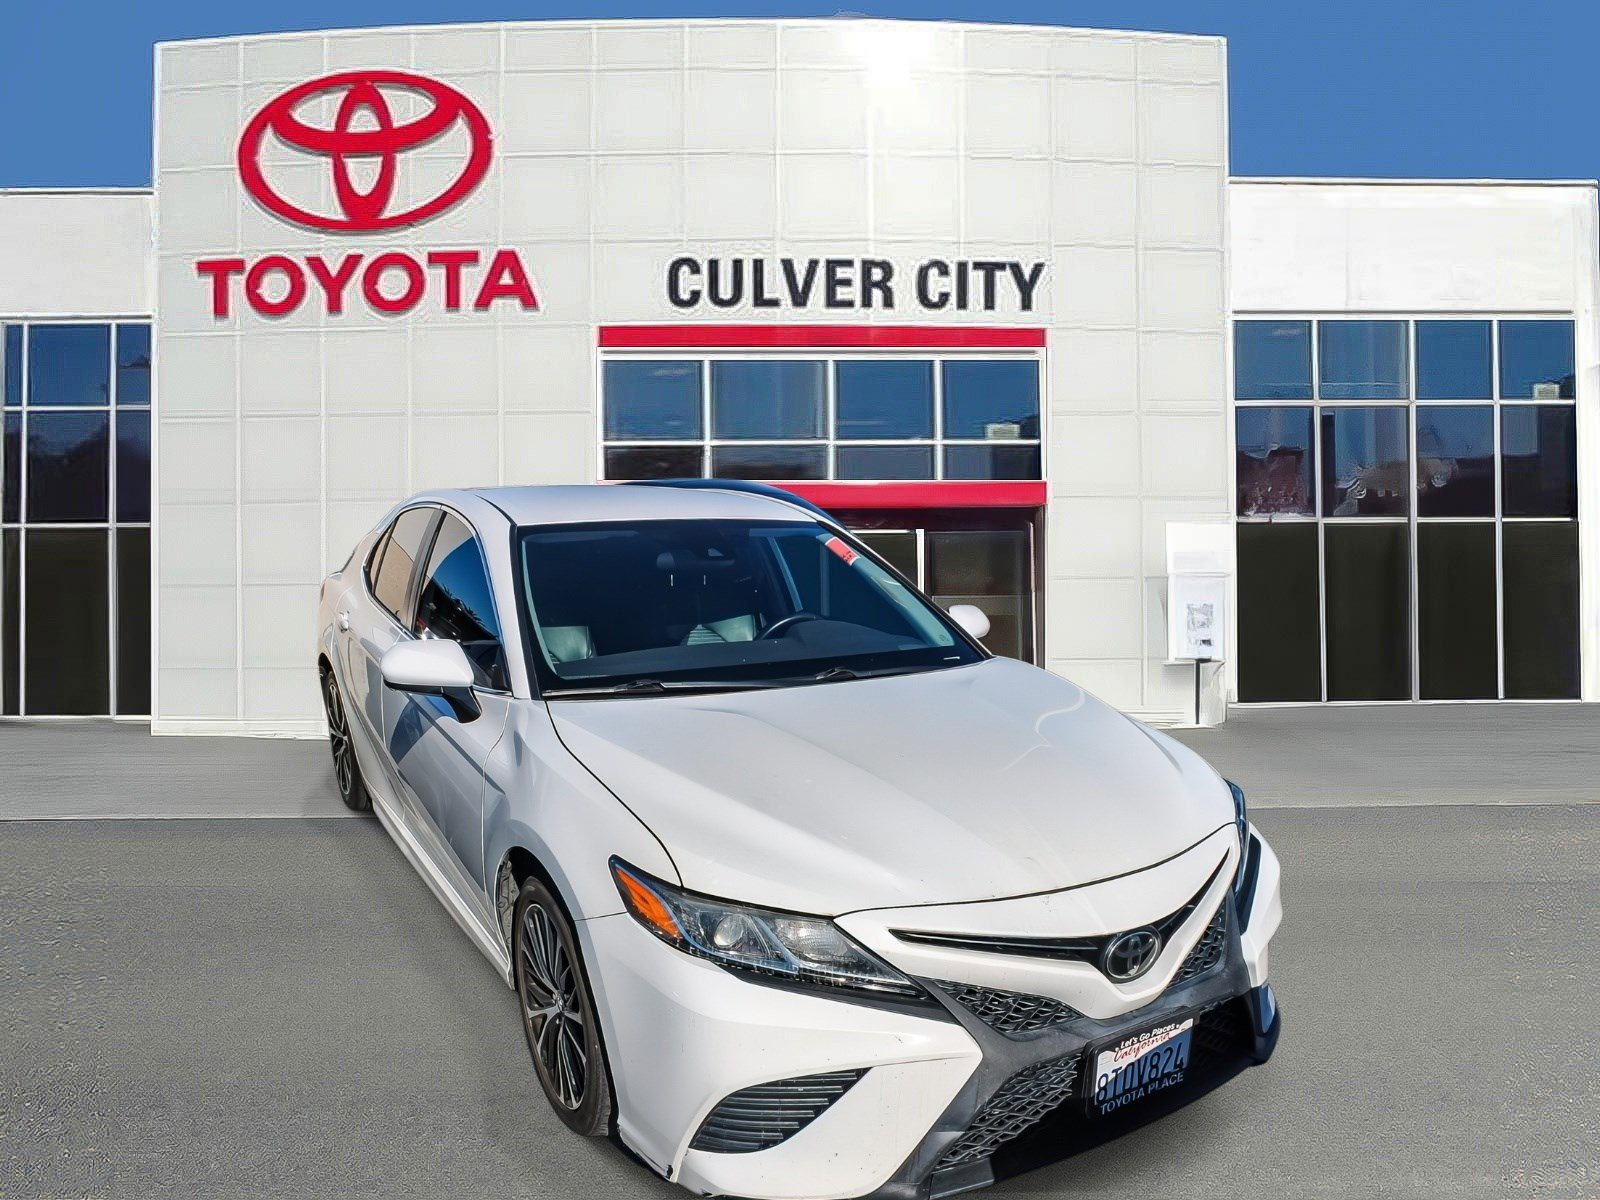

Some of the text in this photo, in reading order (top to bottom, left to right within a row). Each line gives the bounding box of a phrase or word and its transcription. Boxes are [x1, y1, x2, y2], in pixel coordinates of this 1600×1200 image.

[197, 249, 540, 319] TOYOTA
[668, 257, 1046, 312] CULVER CITY
[1120, 1023, 1175, 1049] Let's Go Places
[1100, 1071, 1184, 1115] TOYOTA PLACE
